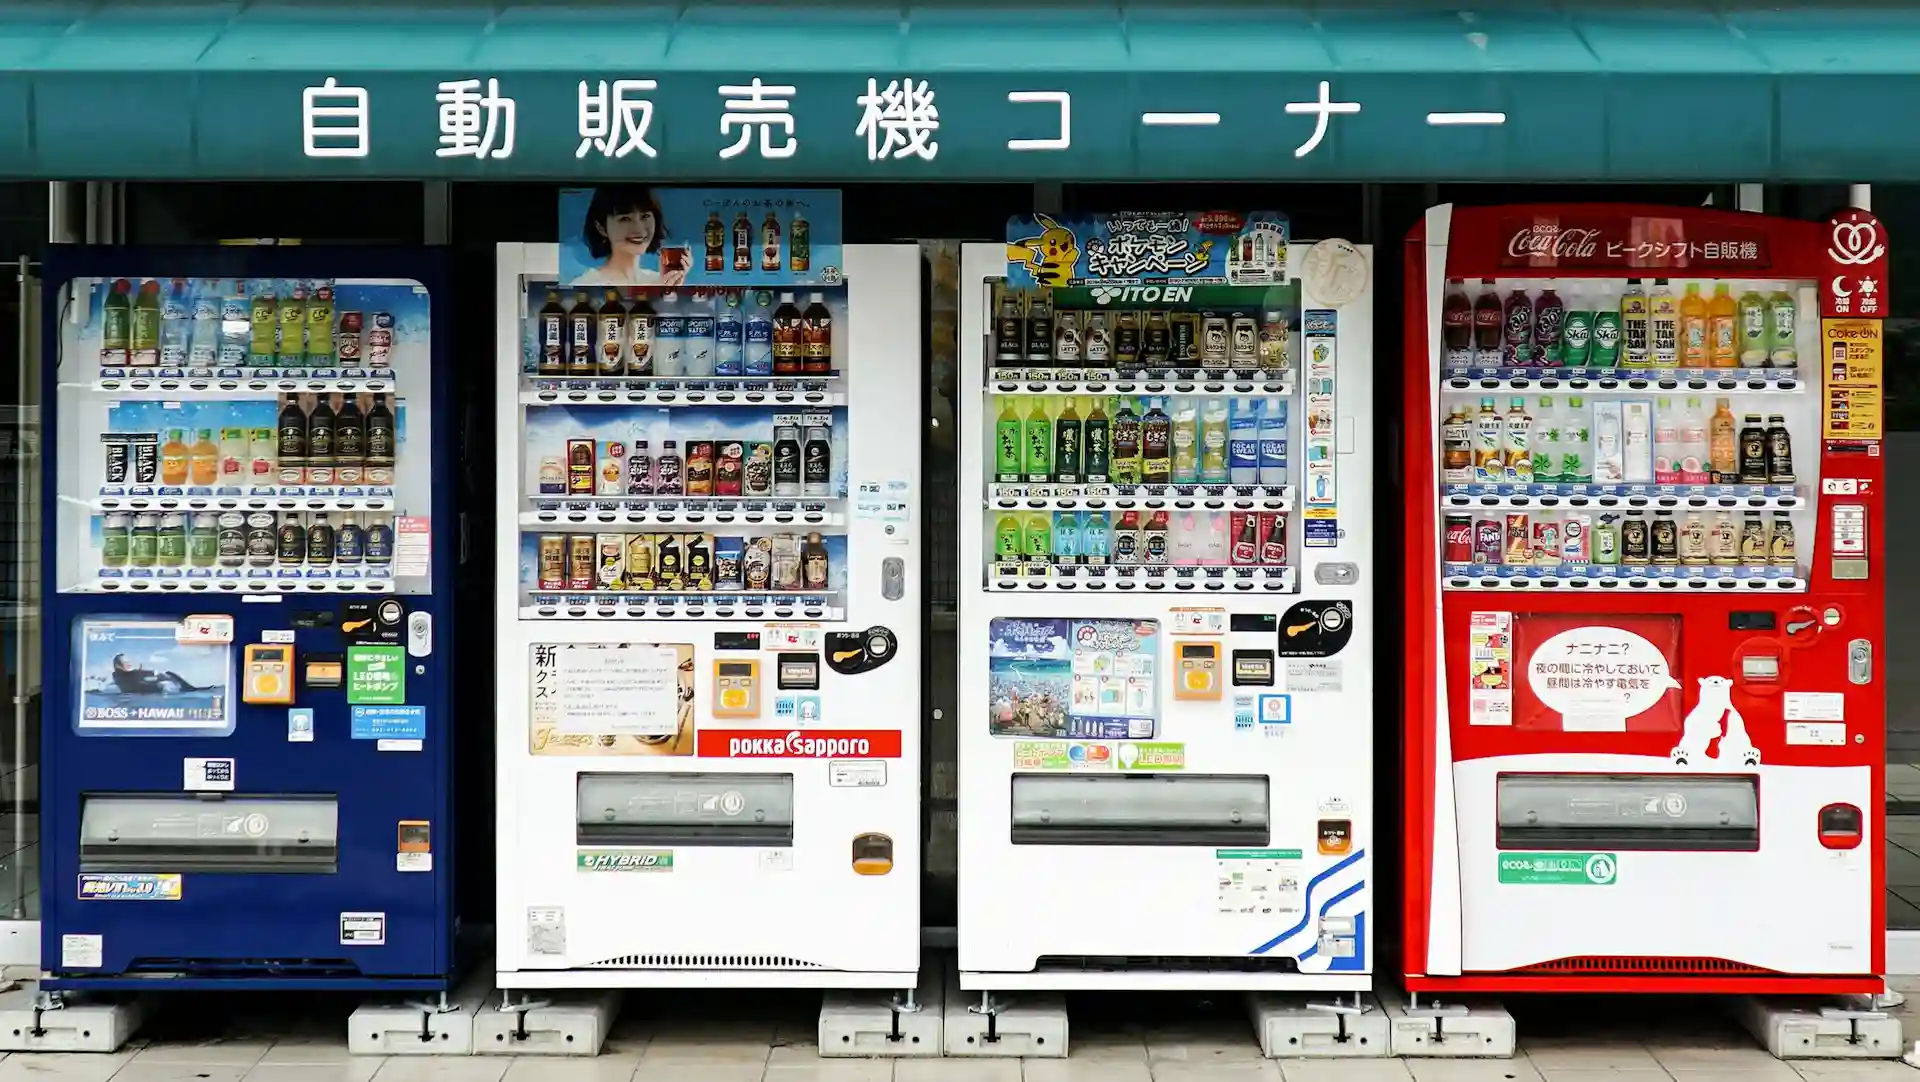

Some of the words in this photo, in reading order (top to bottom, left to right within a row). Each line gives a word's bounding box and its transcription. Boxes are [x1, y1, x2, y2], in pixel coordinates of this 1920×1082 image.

[302, 77, 1506, 161] 自動販売機コーナー
[1107, 233, 1188, 256] ポケモン
[1606, 241, 1759, 260] ピークシフト自販機
[1088, 254, 1208, 276] キャンペーン
[1120, 286, 1160, 302] ITO
[1163, 286, 1194, 302] EN
[1836, 305, 1849, 313] ON
[1860, 305, 1878, 313] OFF
[1627, 320, 1647, 328] THE
[1654, 321, 1675, 329] THE
[1627, 329, 1647, 338] TAN
[1655, 330, 1675, 338] TAN
[1828, 328, 1857, 339] Coke
[1627, 339, 1647, 349] SAN
[1656, 340, 1675, 349] SAN
[112, 447, 123, 481] BLACK
[142, 446, 154, 481] BLACK
[1566, 643, 1630, 655] ナニナニ?
[1536, 663, 1660, 675] 夜の間に冷やしておいて
[1547, 678, 1650, 689] 昼間は冷やす電気を
[97, 707, 129, 719] BOSS
[138, 707, 184, 719] HAWAII
[594, 855, 658, 869] HYBRID
